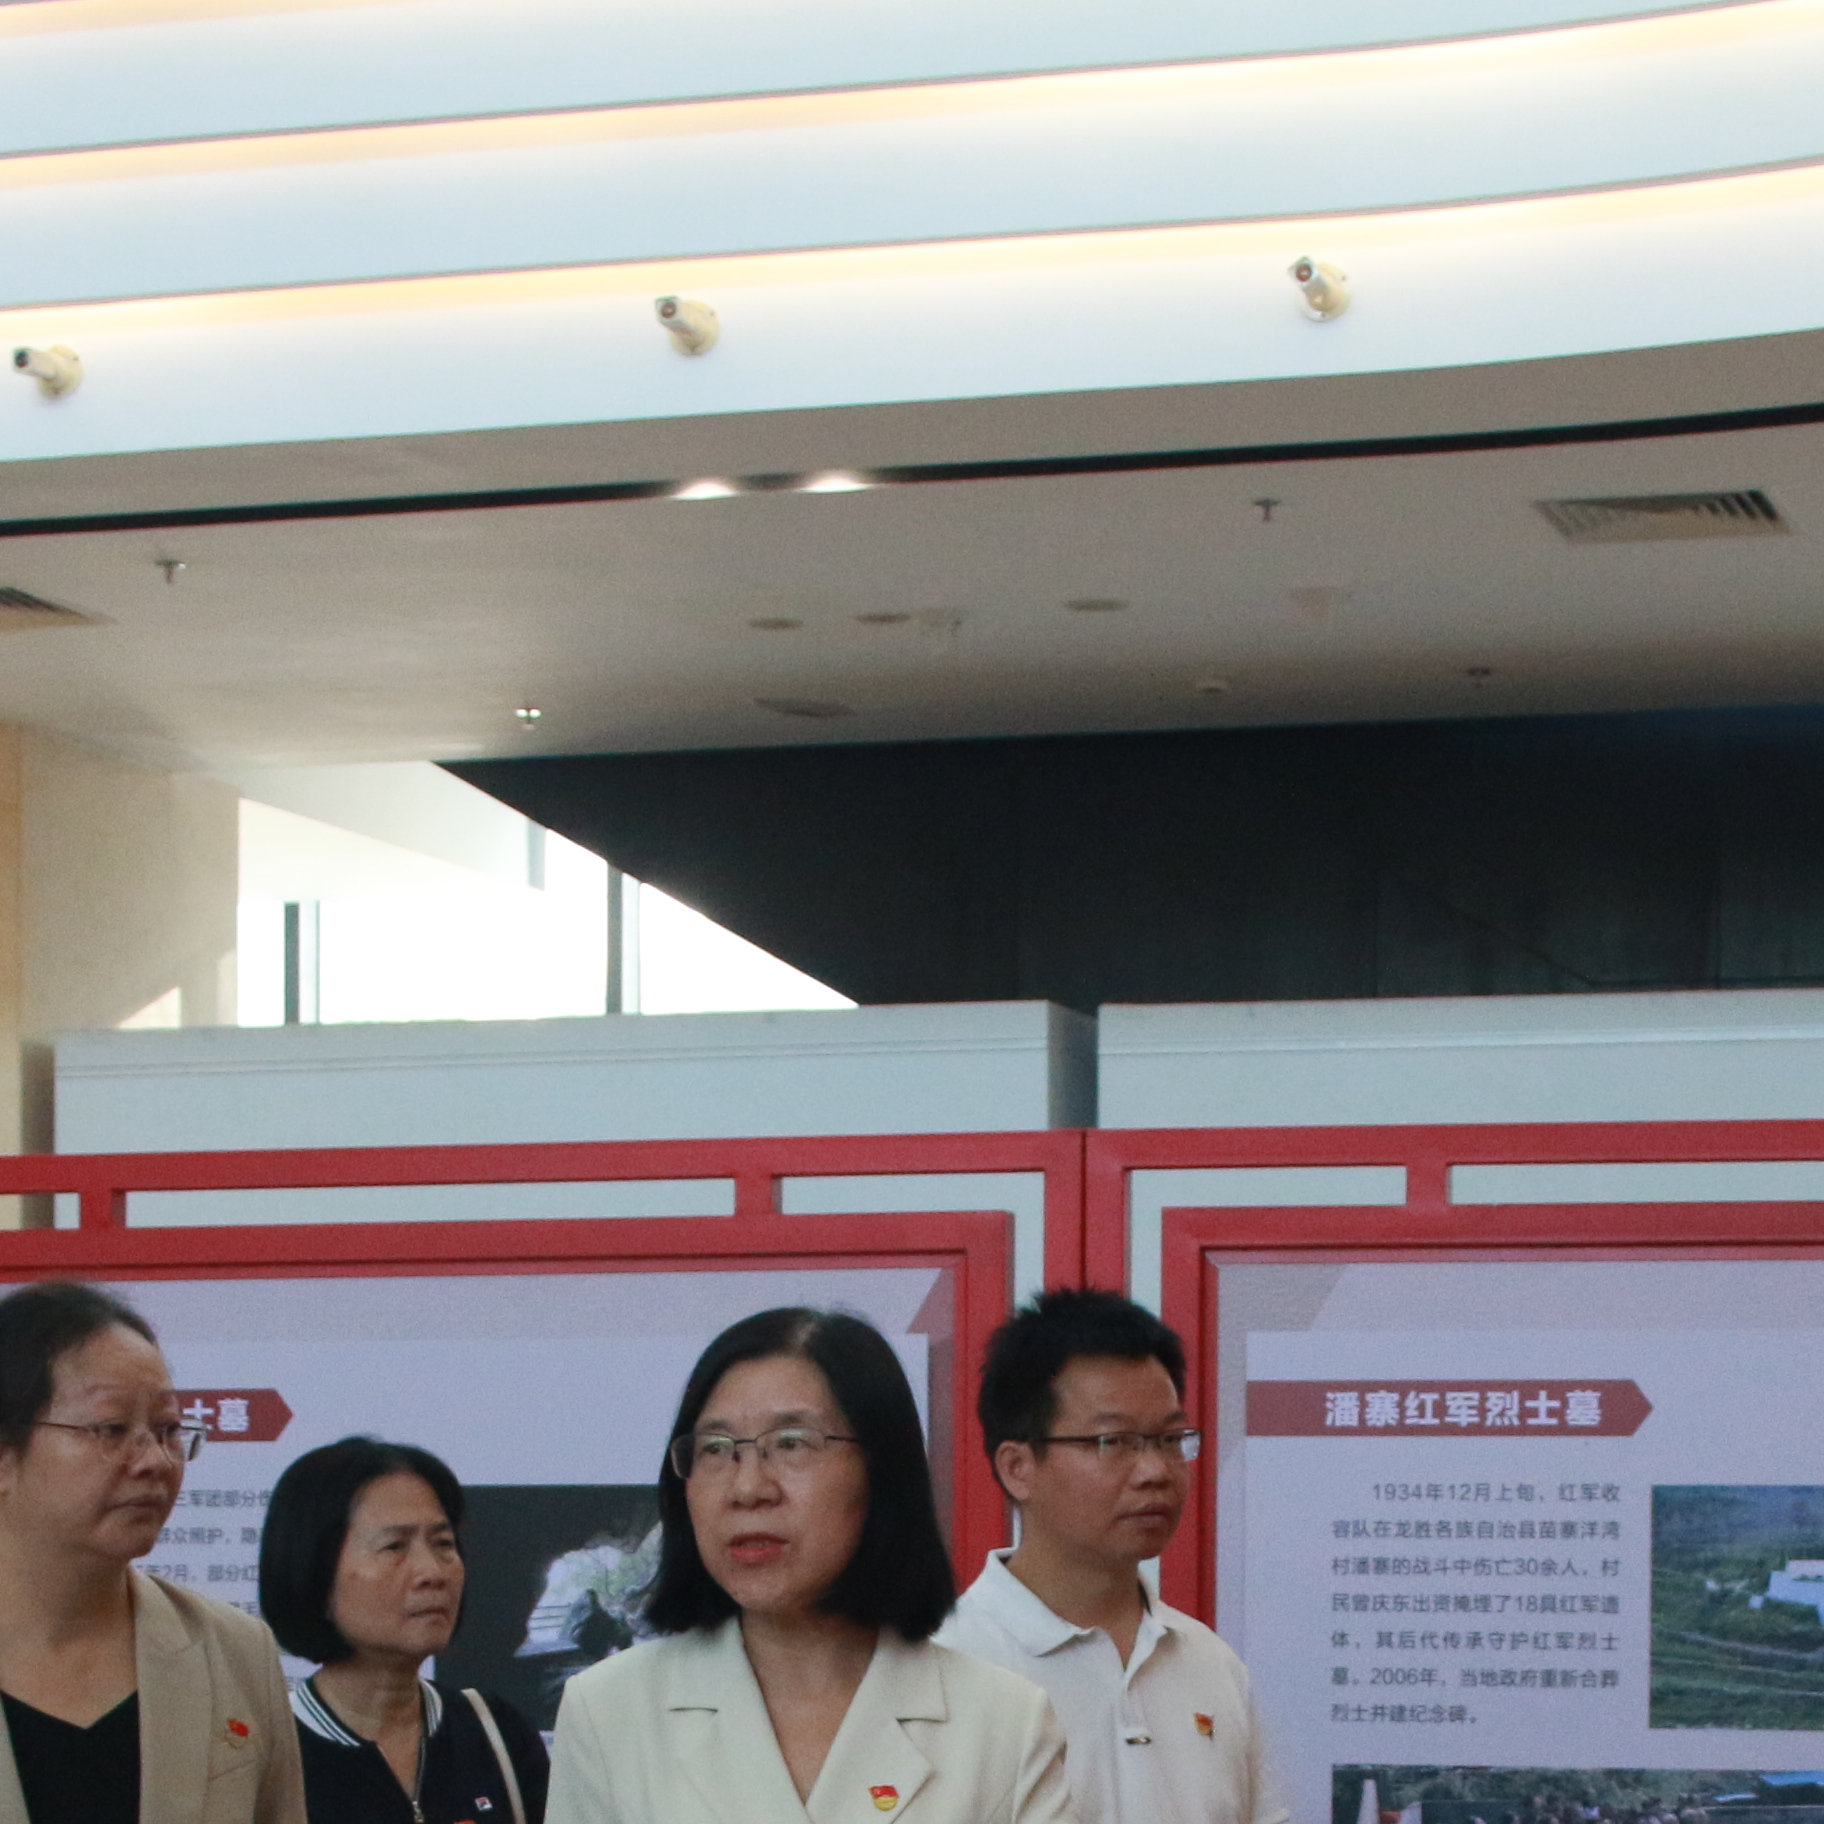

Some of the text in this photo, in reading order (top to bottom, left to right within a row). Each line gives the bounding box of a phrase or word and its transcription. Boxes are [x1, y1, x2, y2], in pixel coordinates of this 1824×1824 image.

[1324, 1389, 1603, 1428] 潘寨红军烈士墓
[1372, 1483, 1621, 1503] 1934年12月上旬，红军收
[1330, 1630, 1620, 1651] 体，其后代传承守护红军烈士
[1330, 1704, 1478, 1724] 烈士并建纪念碑。
